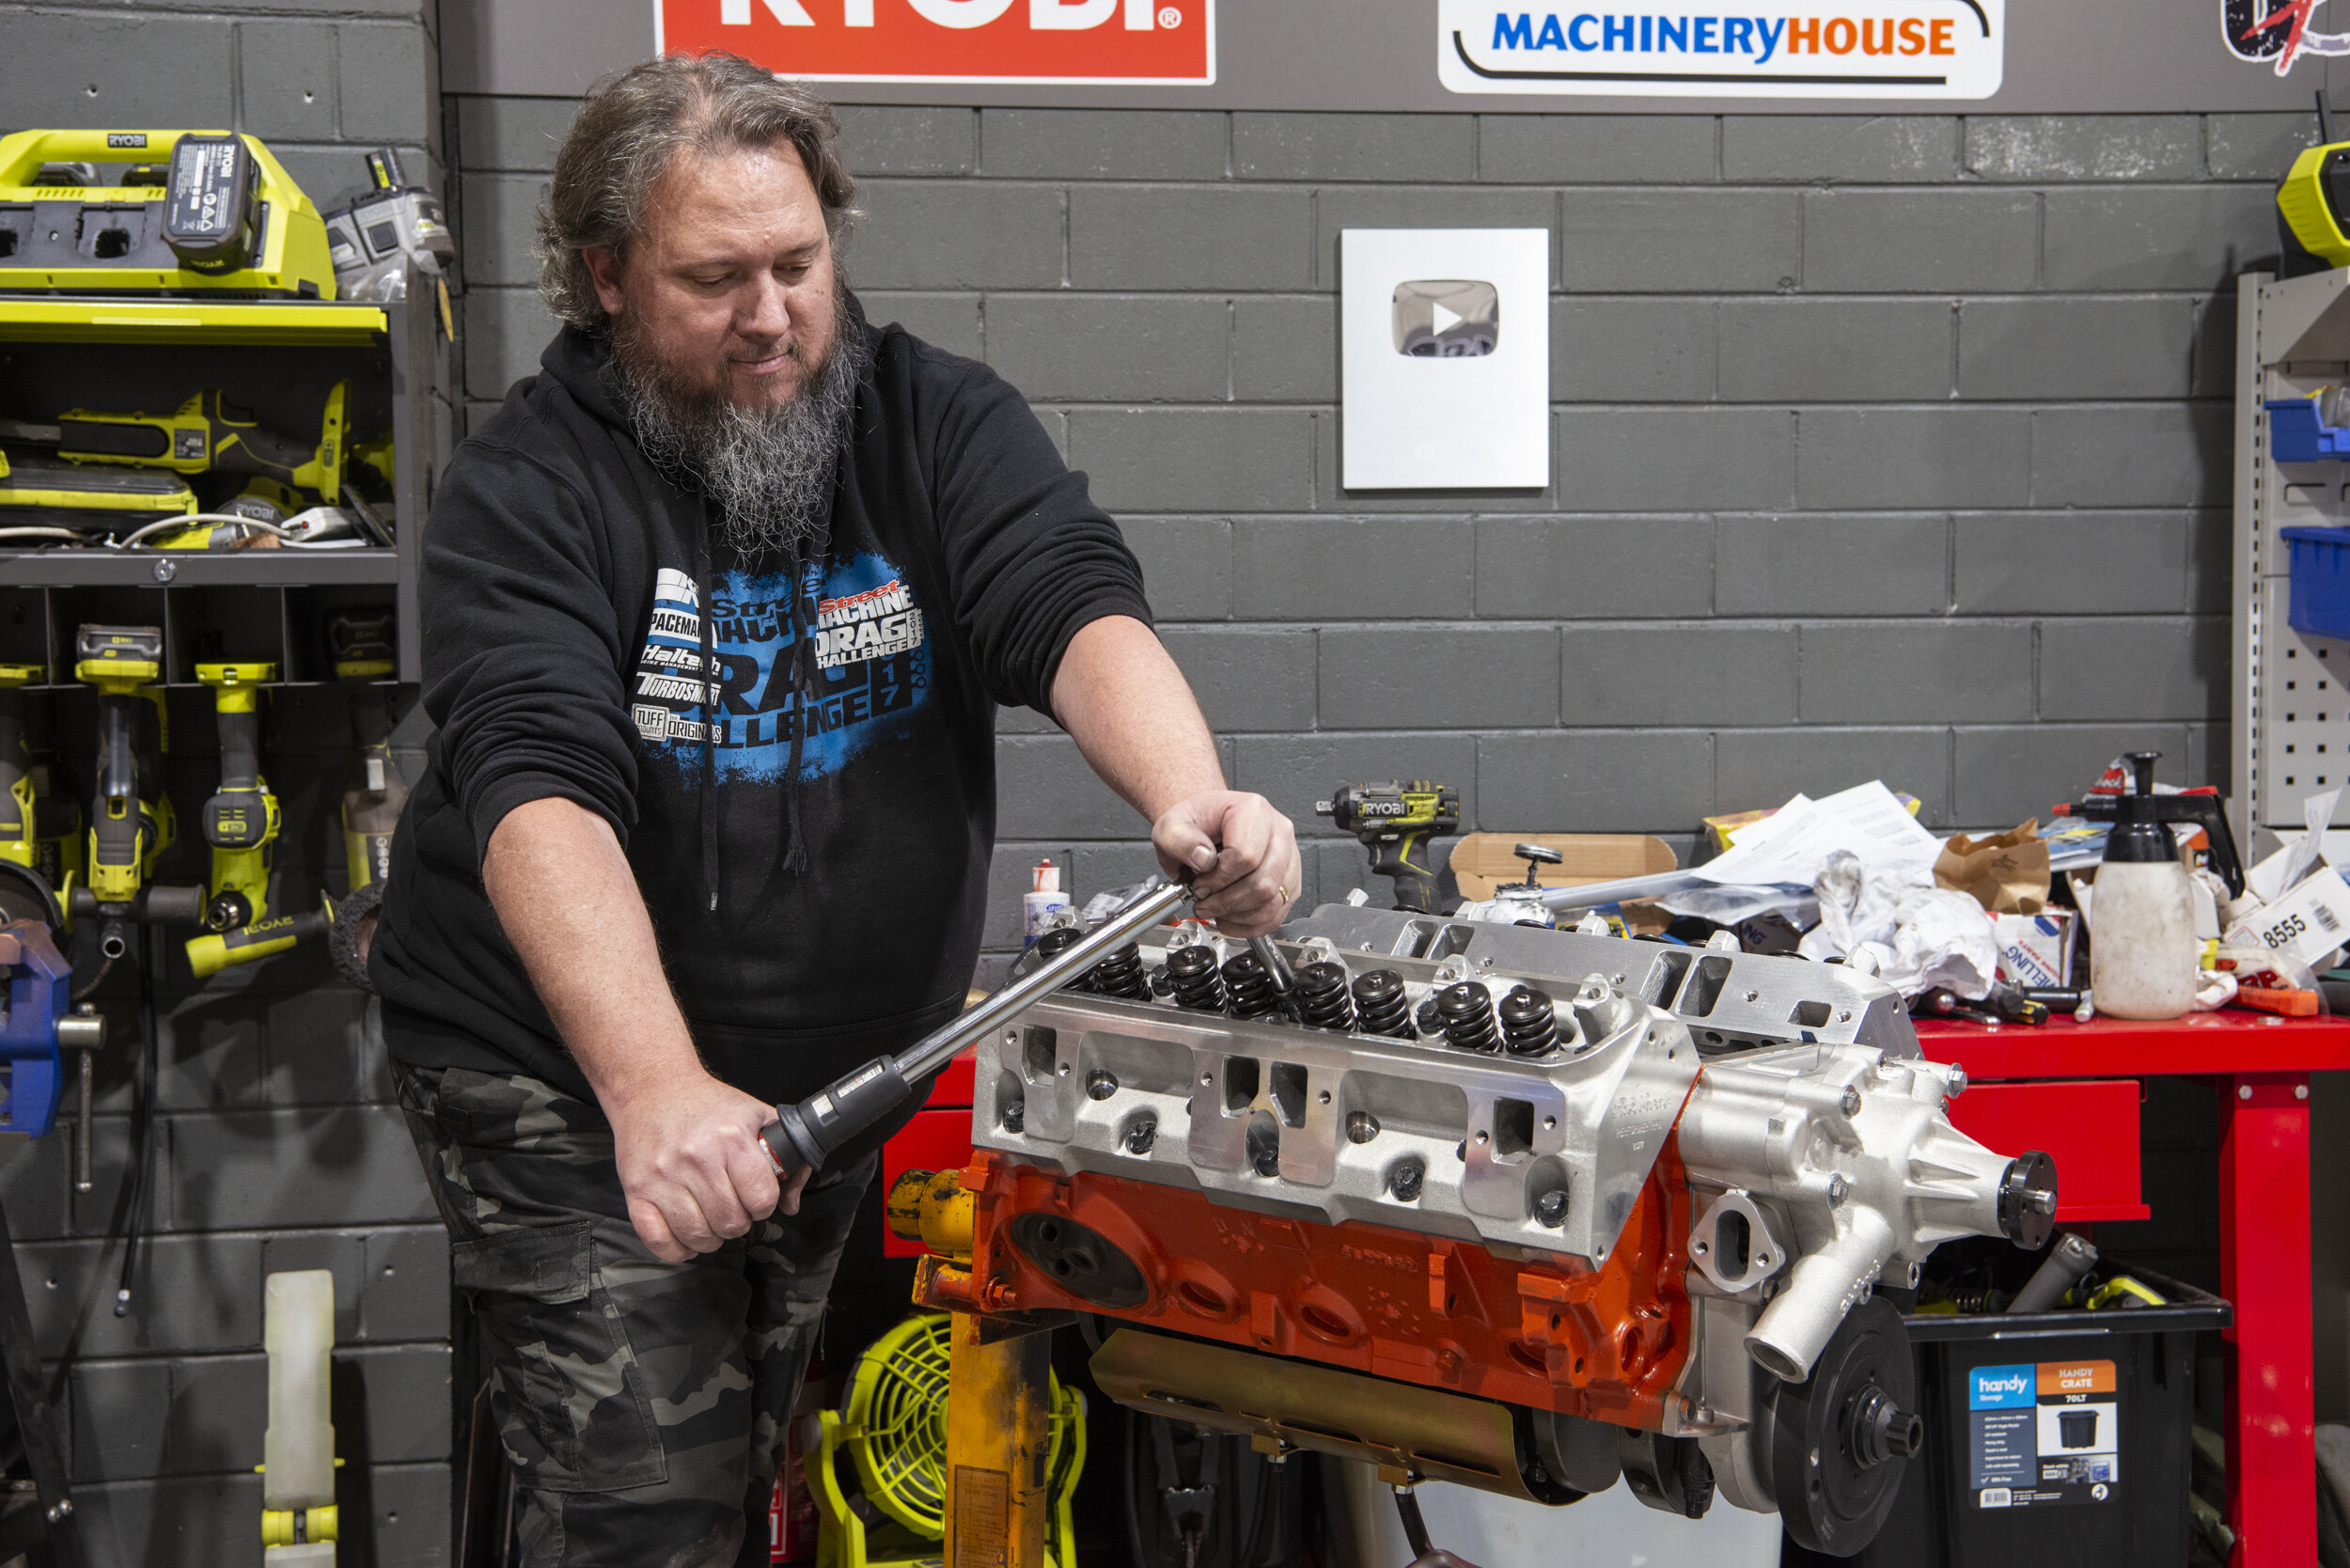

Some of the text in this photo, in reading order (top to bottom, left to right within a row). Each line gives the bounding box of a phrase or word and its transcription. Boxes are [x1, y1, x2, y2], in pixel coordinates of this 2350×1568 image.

[108, 133, 147, 147] RYOBI
[220, 144, 236, 178] RYOBI
[819, 579, 901, 615] Street
[641, 645, 721, 672] Halteh
[817, 640, 909, 670] HALLENGE
[637, 710, 664, 728] TUFF
[1365, 802, 1405, 815] RYOBI
[243, 915, 294, 936] RYOBI
[2264, 913, 2307, 949] 8555
[2059, 1368, 2094, 1378] HANDY
[2060, 1378, 2093, 1388] CRATE
[1979, 1373, 2029, 1395] handy
[2065, 1394, 2088, 1403] 70LT
